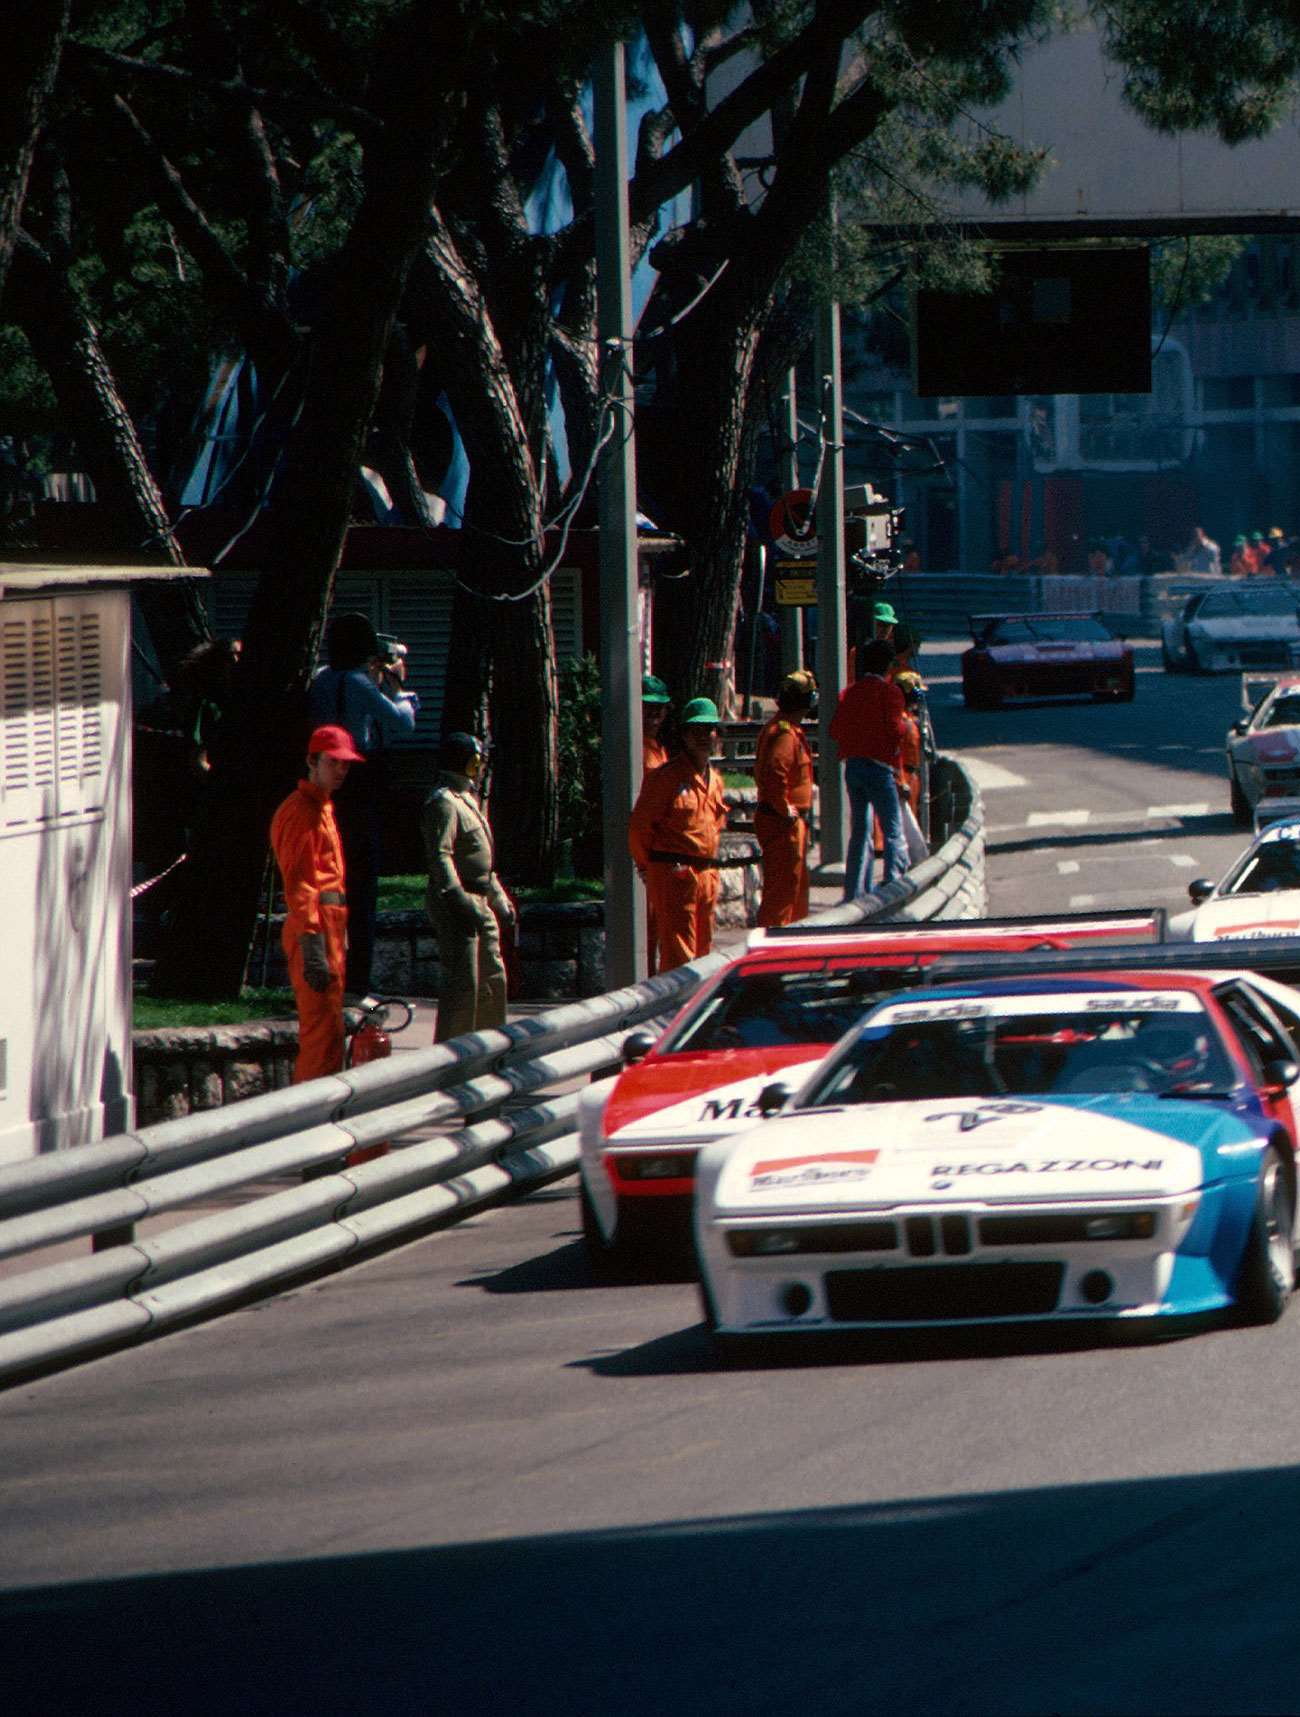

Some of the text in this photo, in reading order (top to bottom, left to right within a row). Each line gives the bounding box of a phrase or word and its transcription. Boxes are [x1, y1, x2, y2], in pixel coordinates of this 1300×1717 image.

[1083, 995, 1182, 1010] saudia
[891, 1002, 984, 1022] saudia
[931, 1159, 1164, 1176] REGAZZONI
